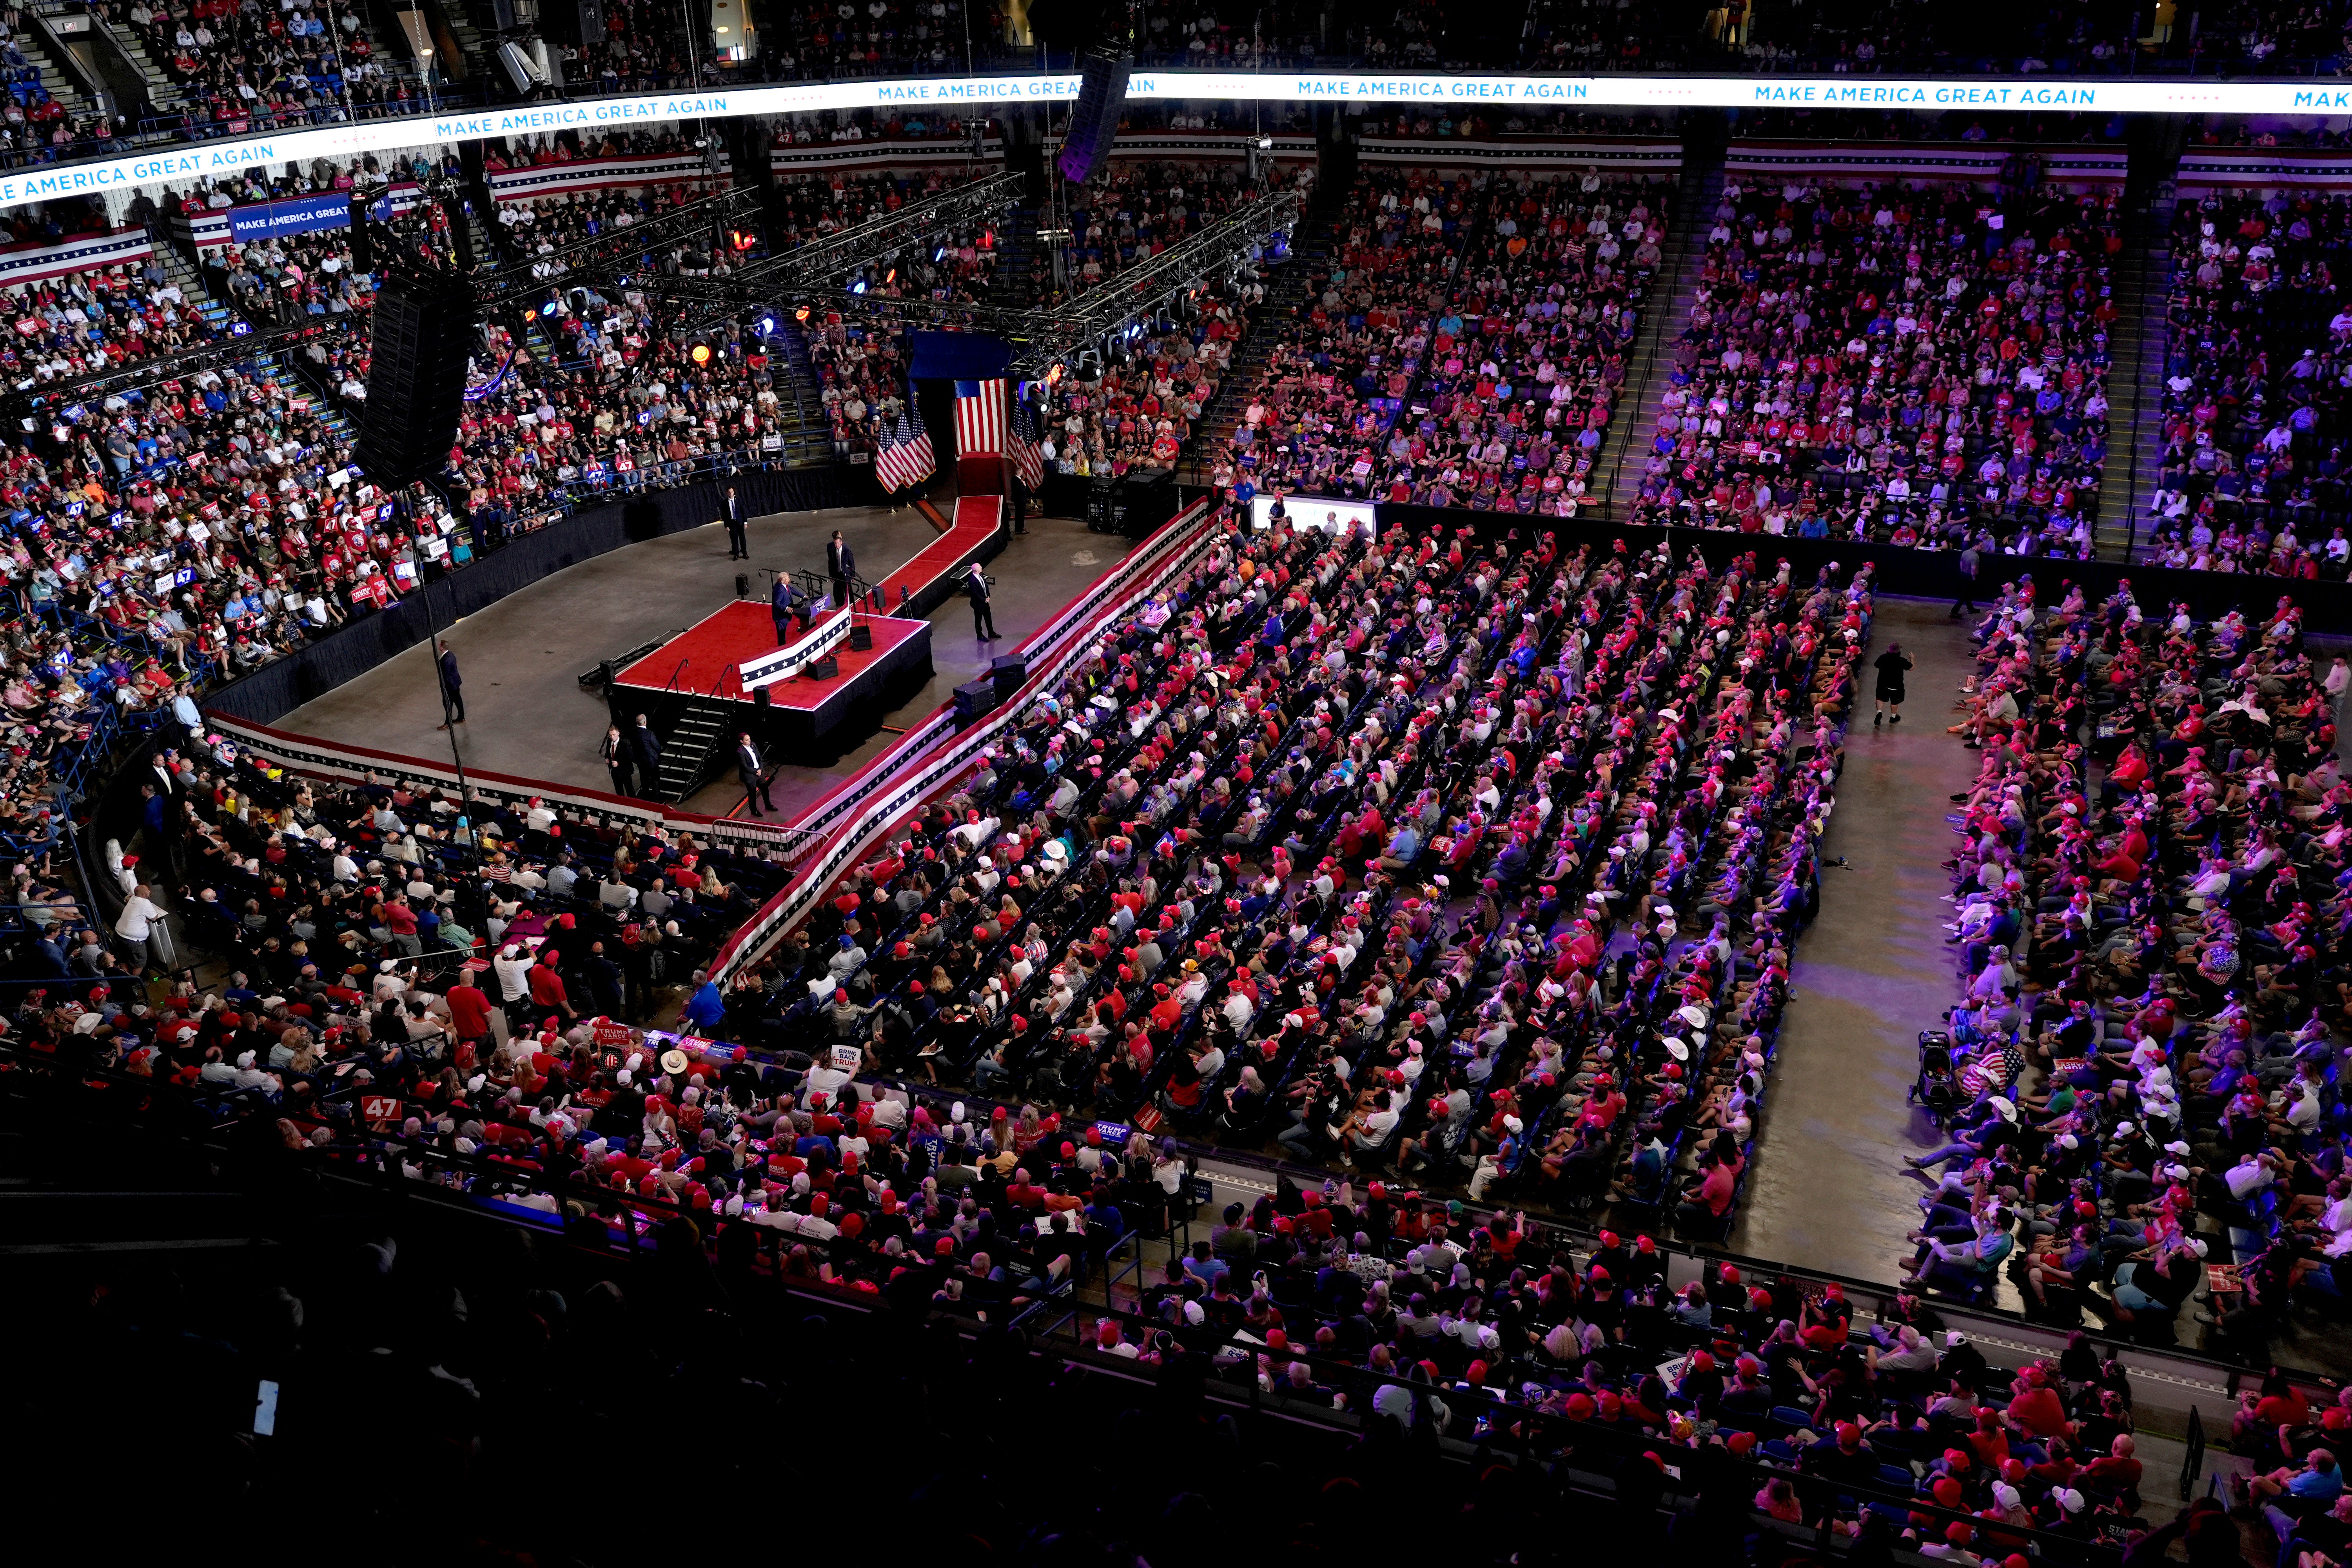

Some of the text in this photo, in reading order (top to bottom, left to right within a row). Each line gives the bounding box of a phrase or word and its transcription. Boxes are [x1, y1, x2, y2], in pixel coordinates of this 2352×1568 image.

[879, 86, 929, 99] MAKE
[938, 84, 1020, 97] AMERICA
[1299, 82, 1586, 98] MAKE AMERICA GREAT AGAIN
[1756, 87, 2095, 104] MAKE AMERICA GREAT AGAIN
[437, 99, 726, 136] MAKE AMERICA GREAT AGAIN
[26, 168, 126, 202] AMERICA
[134, 155, 200, 178] GREAT
[212, 145, 273, 166] AGAIN
[236, 207, 348, 230] MAKE AMERICA GREAT
[234, 323, 247, 333] 47
[65, 405, 79, 418] TRUMP
[69, 409, 82, 419] VANCE
[639, 413, 649, 423] 47
[619, 461, 632, 471] 47
[69, 502, 82, 515] 47
[380, 504, 392, 518] 47
[111, 513, 122, 526] 47
[326, 519, 336, 530] 47
[440, 517, 451, 526] TRUMP
[166, 521, 180, 530] TRUMP
[191, 526, 205, 535] TRUMP
[177, 569, 191, 583] 47
[241, 575, 260, 588] TRUMP
[99, 582, 113, 592] TRUMP
[353, 588, 370, 596] TRUMP
[354, 591, 370, 599] VANCE
[1307, 938, 1327, 949] TRUMP
[1312, 942, 1326, 950] VANCE
[737, 970, 749, 988] 47
[685, 1037, 711, 1046] TRUMP
[366, 1098, 397, 1117] 47
[1096, 1124, 1127, 1132] TRUMP
